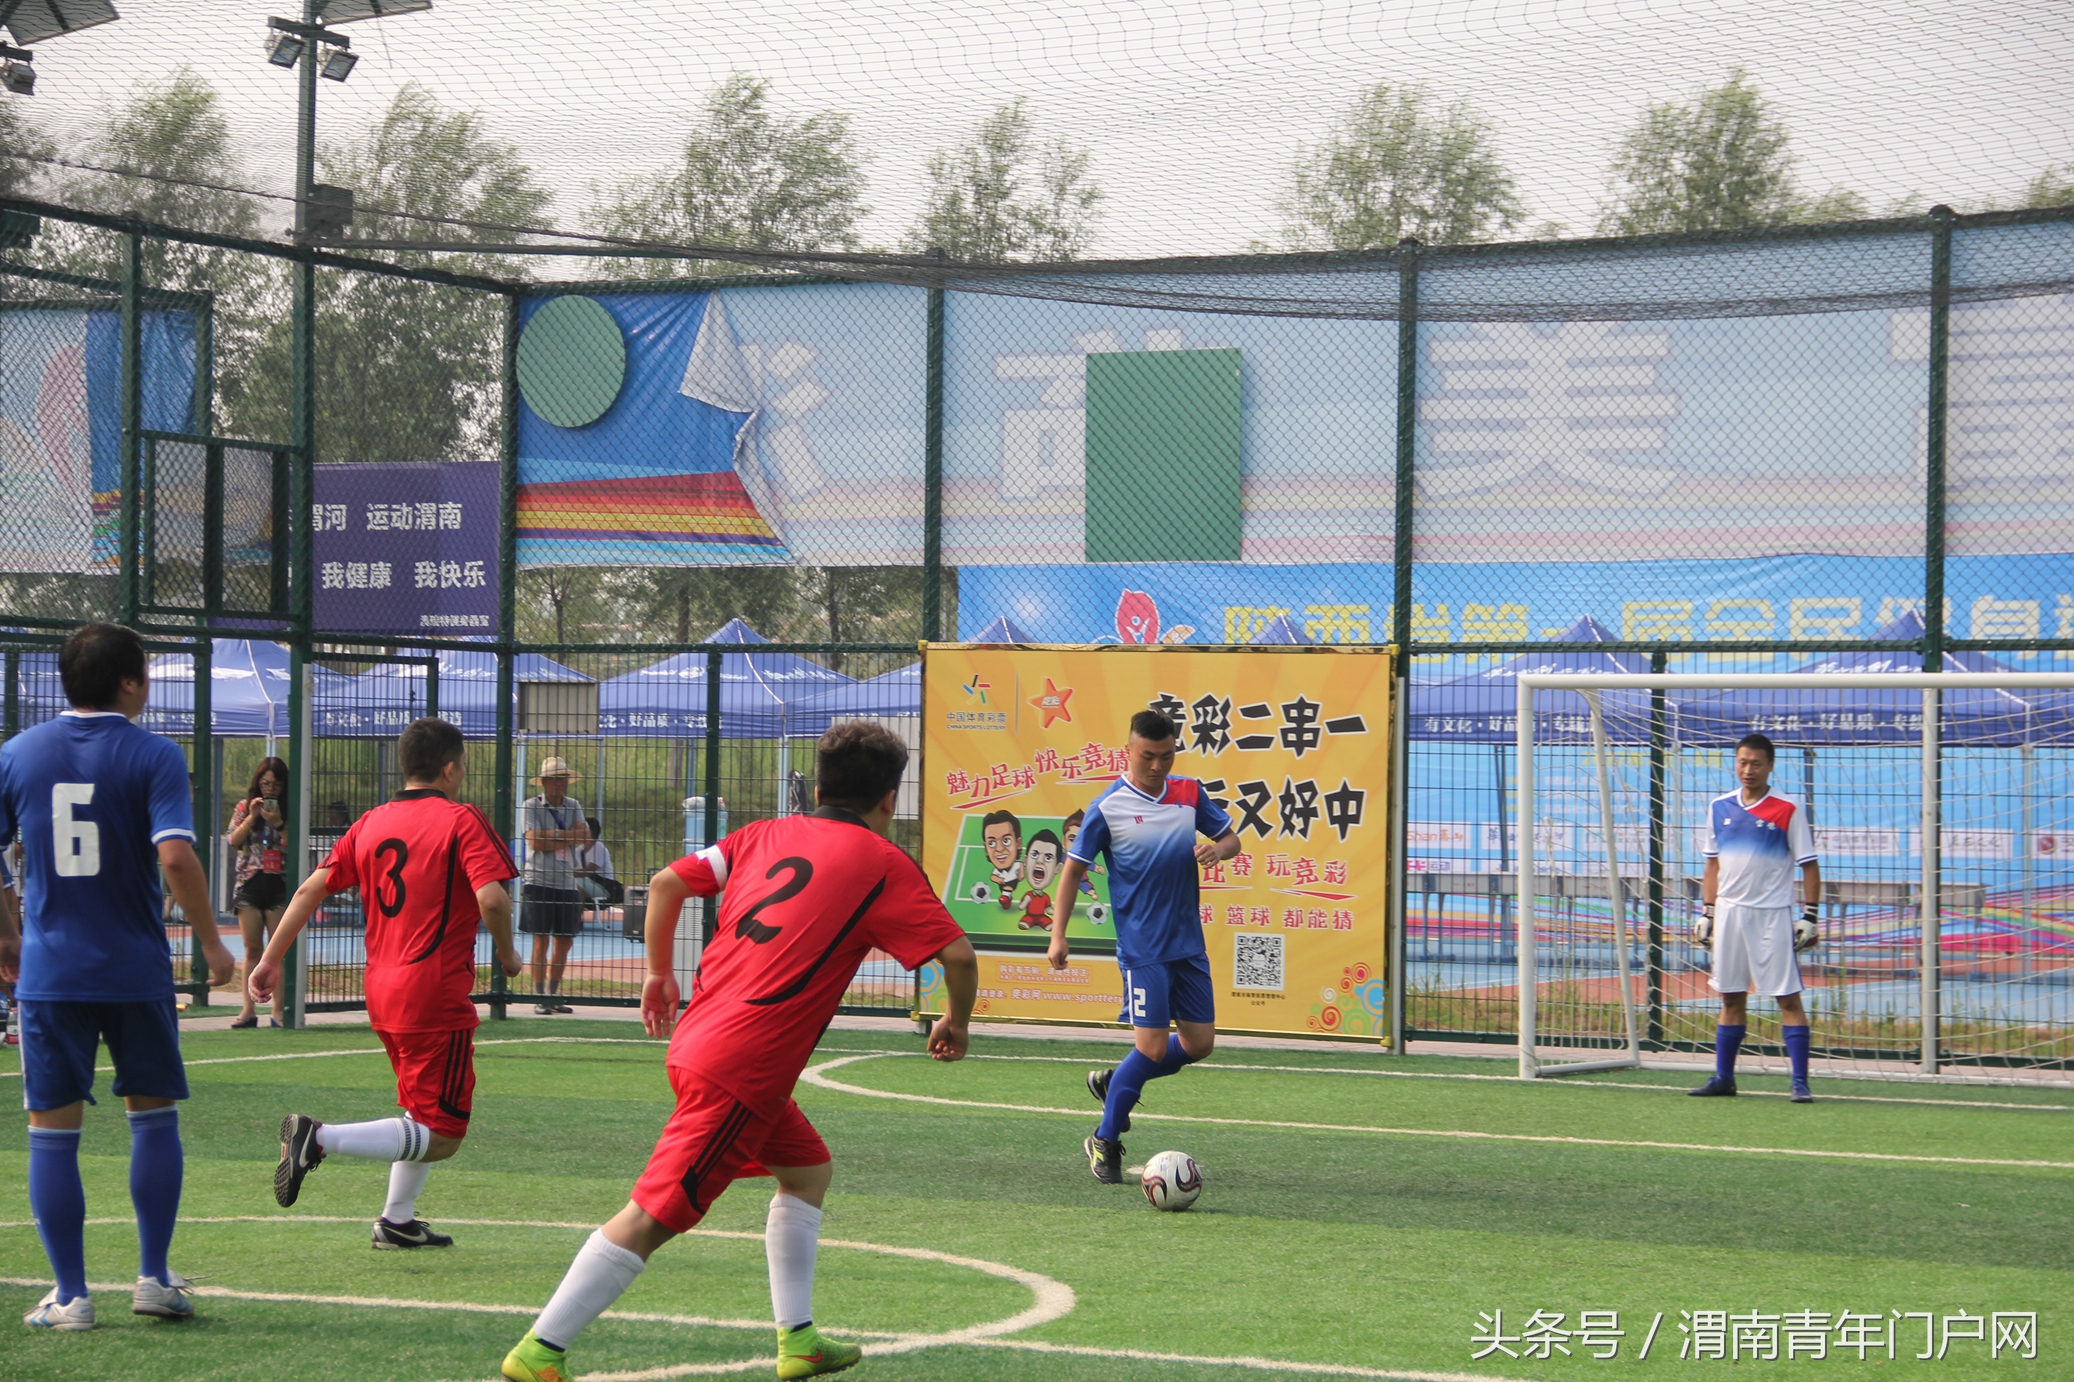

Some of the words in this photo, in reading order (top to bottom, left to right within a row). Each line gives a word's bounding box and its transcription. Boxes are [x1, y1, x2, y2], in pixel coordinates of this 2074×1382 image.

[366, 501, 463, 531] 运动渭南
[322, 561, 392, 589] 我健康
[414, 560, 486, 589] 我快乐
[947, 712, 1006, 723] 中国体育彩票
[946, 762, 1036, 798] 魅力足球
[1034, 741, 1130, 779] 快乐竞猜
[52, 783, 101, 877] 6
[374, 838, 409, 918] 3
[1265, 853, 1348, 887] 玩竞彩
[735, 856, 814, 945] 2
[1226, 905, 1271, 927] 篮球
[1284, 908, 1354, 930] 都能猜
